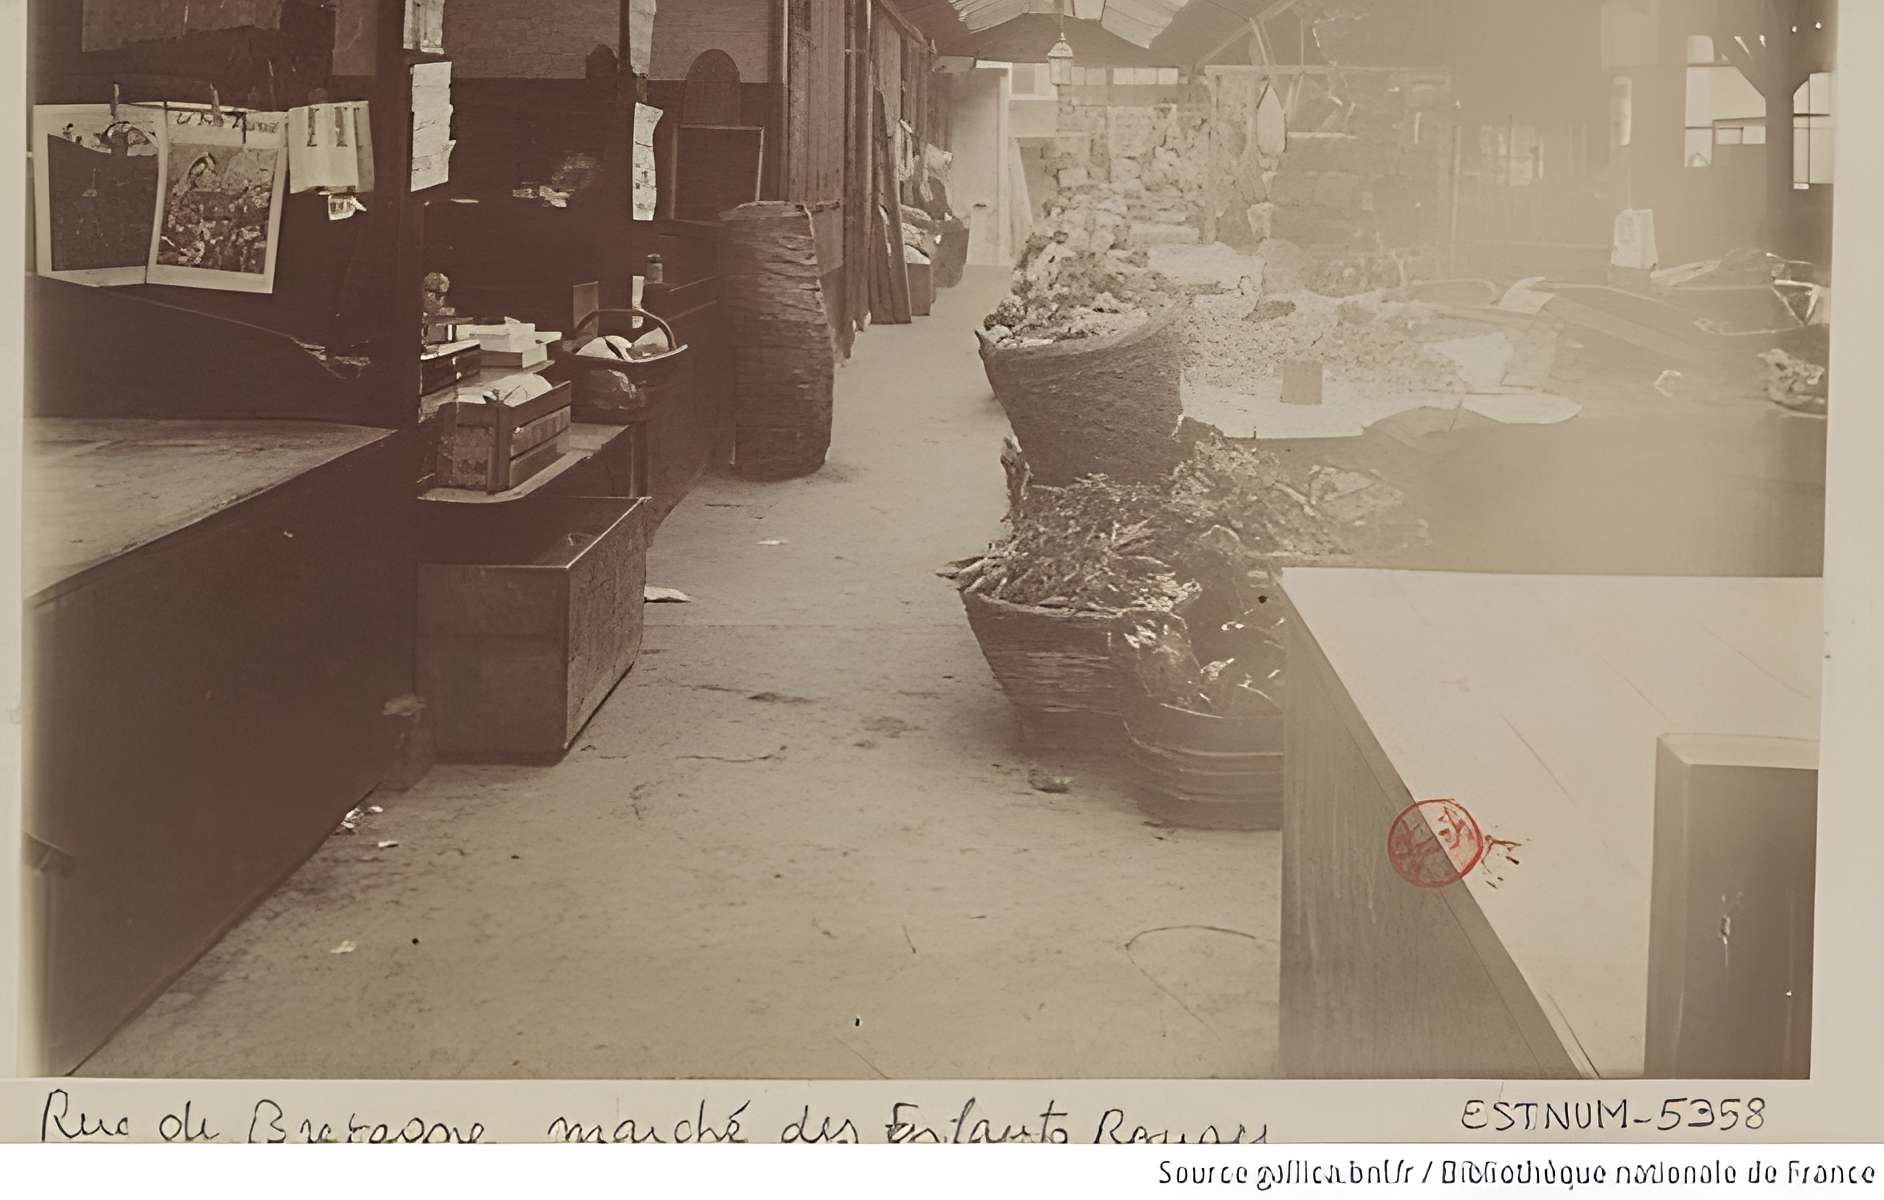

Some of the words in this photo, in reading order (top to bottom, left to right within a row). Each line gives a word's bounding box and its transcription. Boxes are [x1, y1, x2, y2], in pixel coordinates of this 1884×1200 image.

[41, 1088, 130, 1142] Rue
[158, 1100, 220, 1140] de
[1461, 1096, 1766, 1132] ESTNUM-5358
